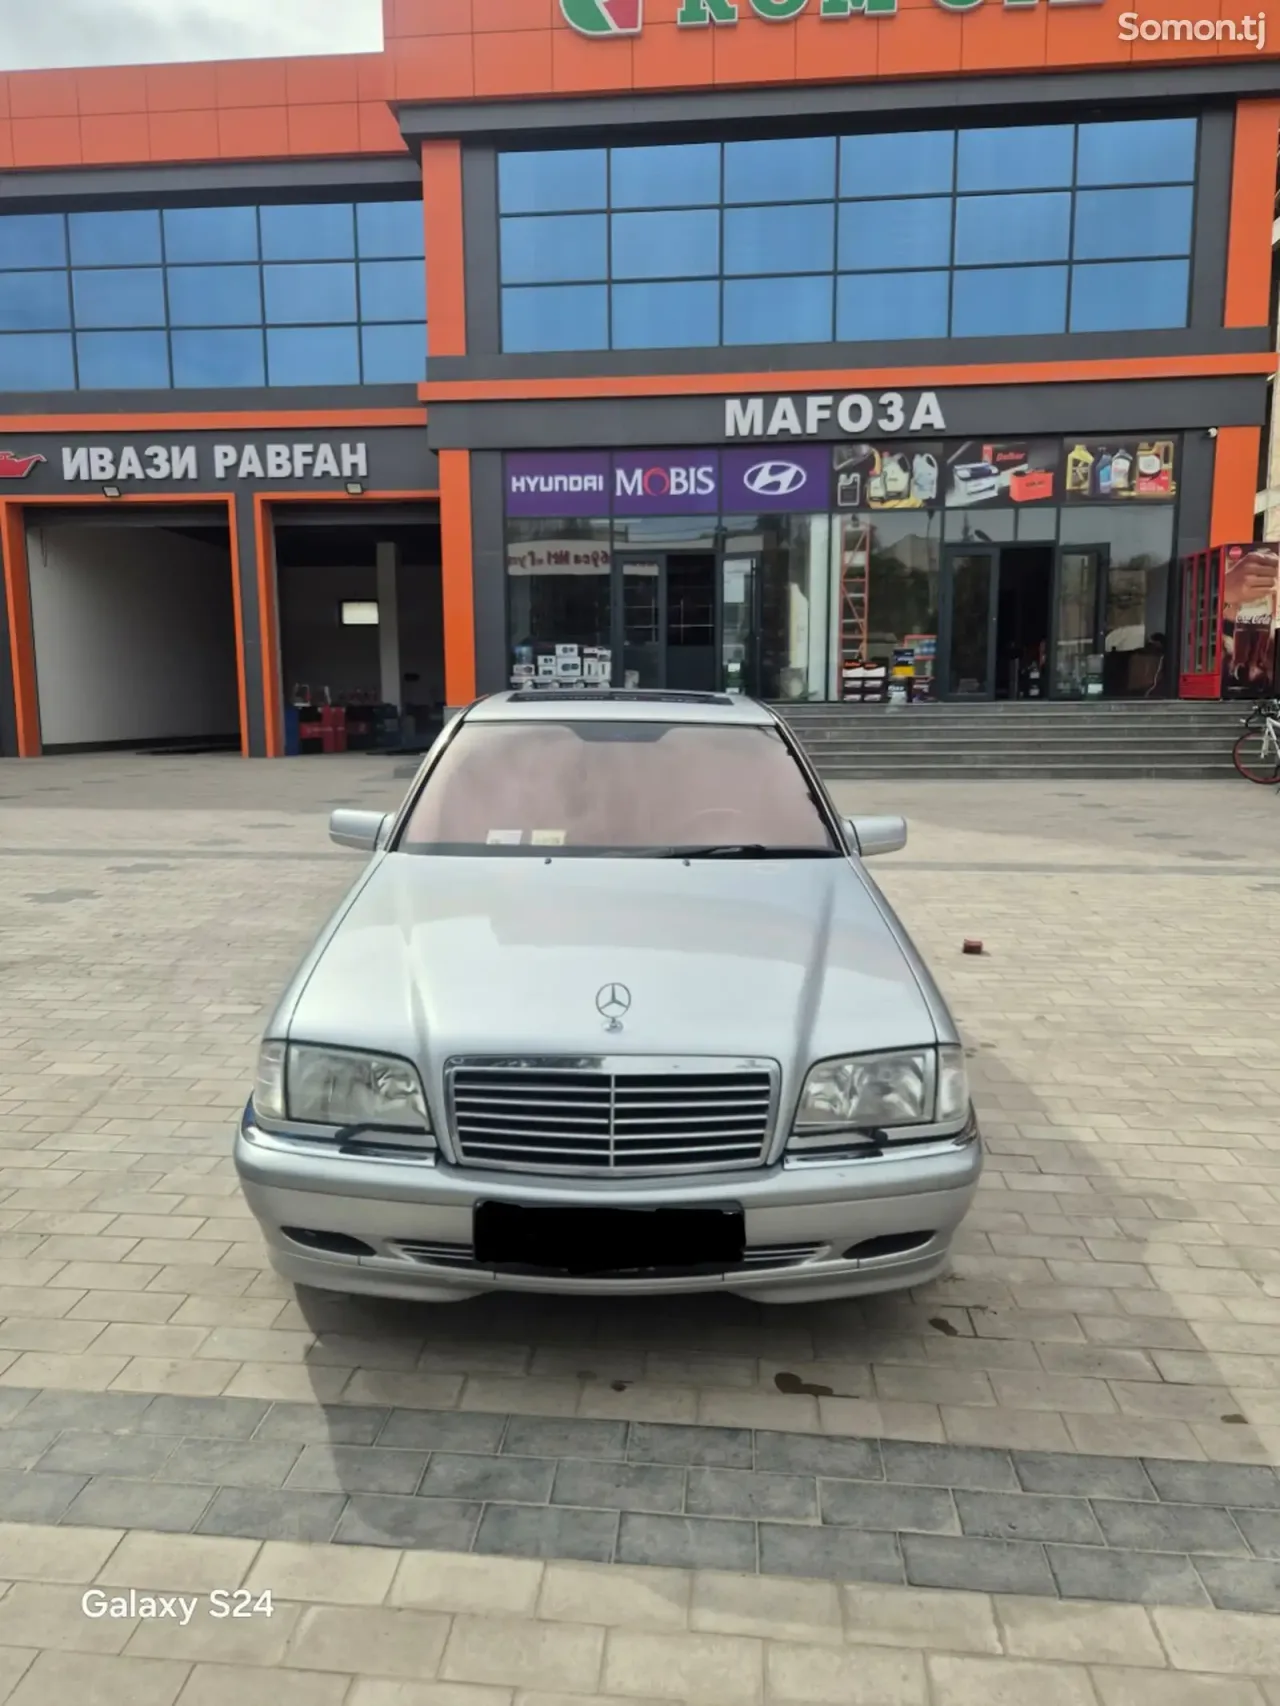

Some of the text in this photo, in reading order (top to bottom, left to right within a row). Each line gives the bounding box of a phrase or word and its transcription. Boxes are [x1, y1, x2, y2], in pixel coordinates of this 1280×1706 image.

[61, 446, 198, 481] ИВАЗИ
[511, 474, 604, 493] HYUNDAI
[615, 467, 715, 496] MOBIS
